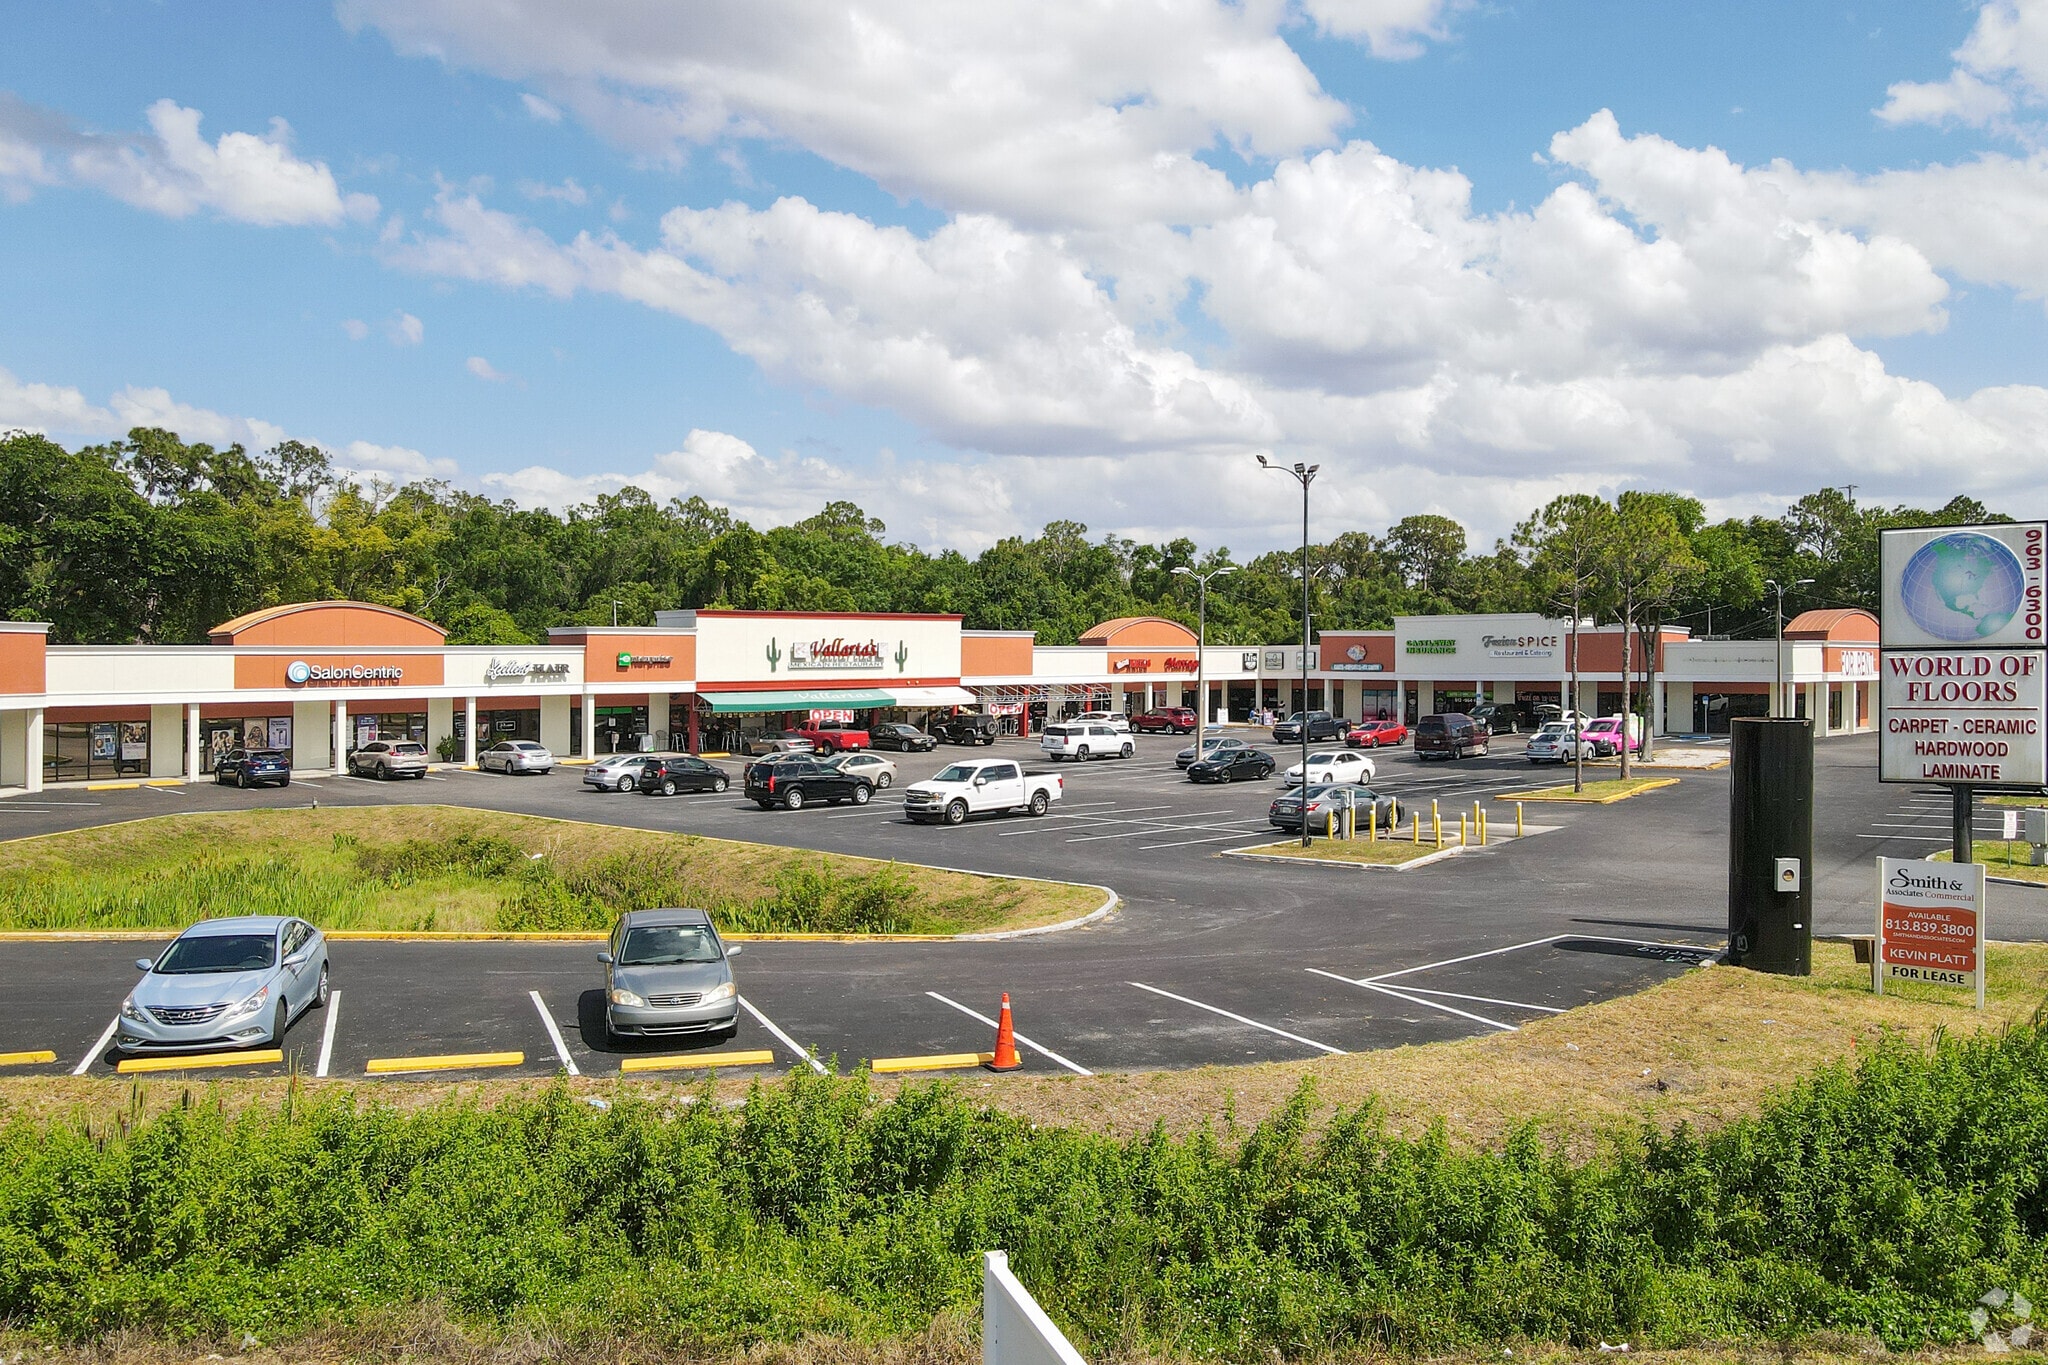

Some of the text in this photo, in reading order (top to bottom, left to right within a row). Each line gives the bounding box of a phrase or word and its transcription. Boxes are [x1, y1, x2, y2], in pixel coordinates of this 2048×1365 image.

[2025, 529, 2042, 639] 963-6300
[810, 638, 877, 658] Vallarta's
[1518, 636, 1557, 647] SPICE
[310, 665, 403, 679] SalonCentric
[533, 663, 570, 674] HAIR
[1841, 651, 1873, 676] FOR RENT
[1889, 656, 2038, 677] WORLD OF
[1907, 681, 2018, 702] FLOORS
[811, 709, 853, 721] OPEN
[990, 703, 1022, 714] OPEN
[1889, 718, 1949, 733] CARPET
[1963, 719, 2037, 735] CERAMIC
[1915, 741, 2008, 757] HARDWOOD
[1923, 763, 2001, 779] LAMINATE
[1890, 868, 1963, 891] Smith &
[1886, 888, 1974, 901] Associates Commercial
[1908, 911, 1951, 921] AVAILABLE
[1885, 918, 1974, 937] 813.839.3800
[1890, 948, 1968, 965] KEVIN PLATT
[1892, 966, 1965, 984] FOR LEASE
